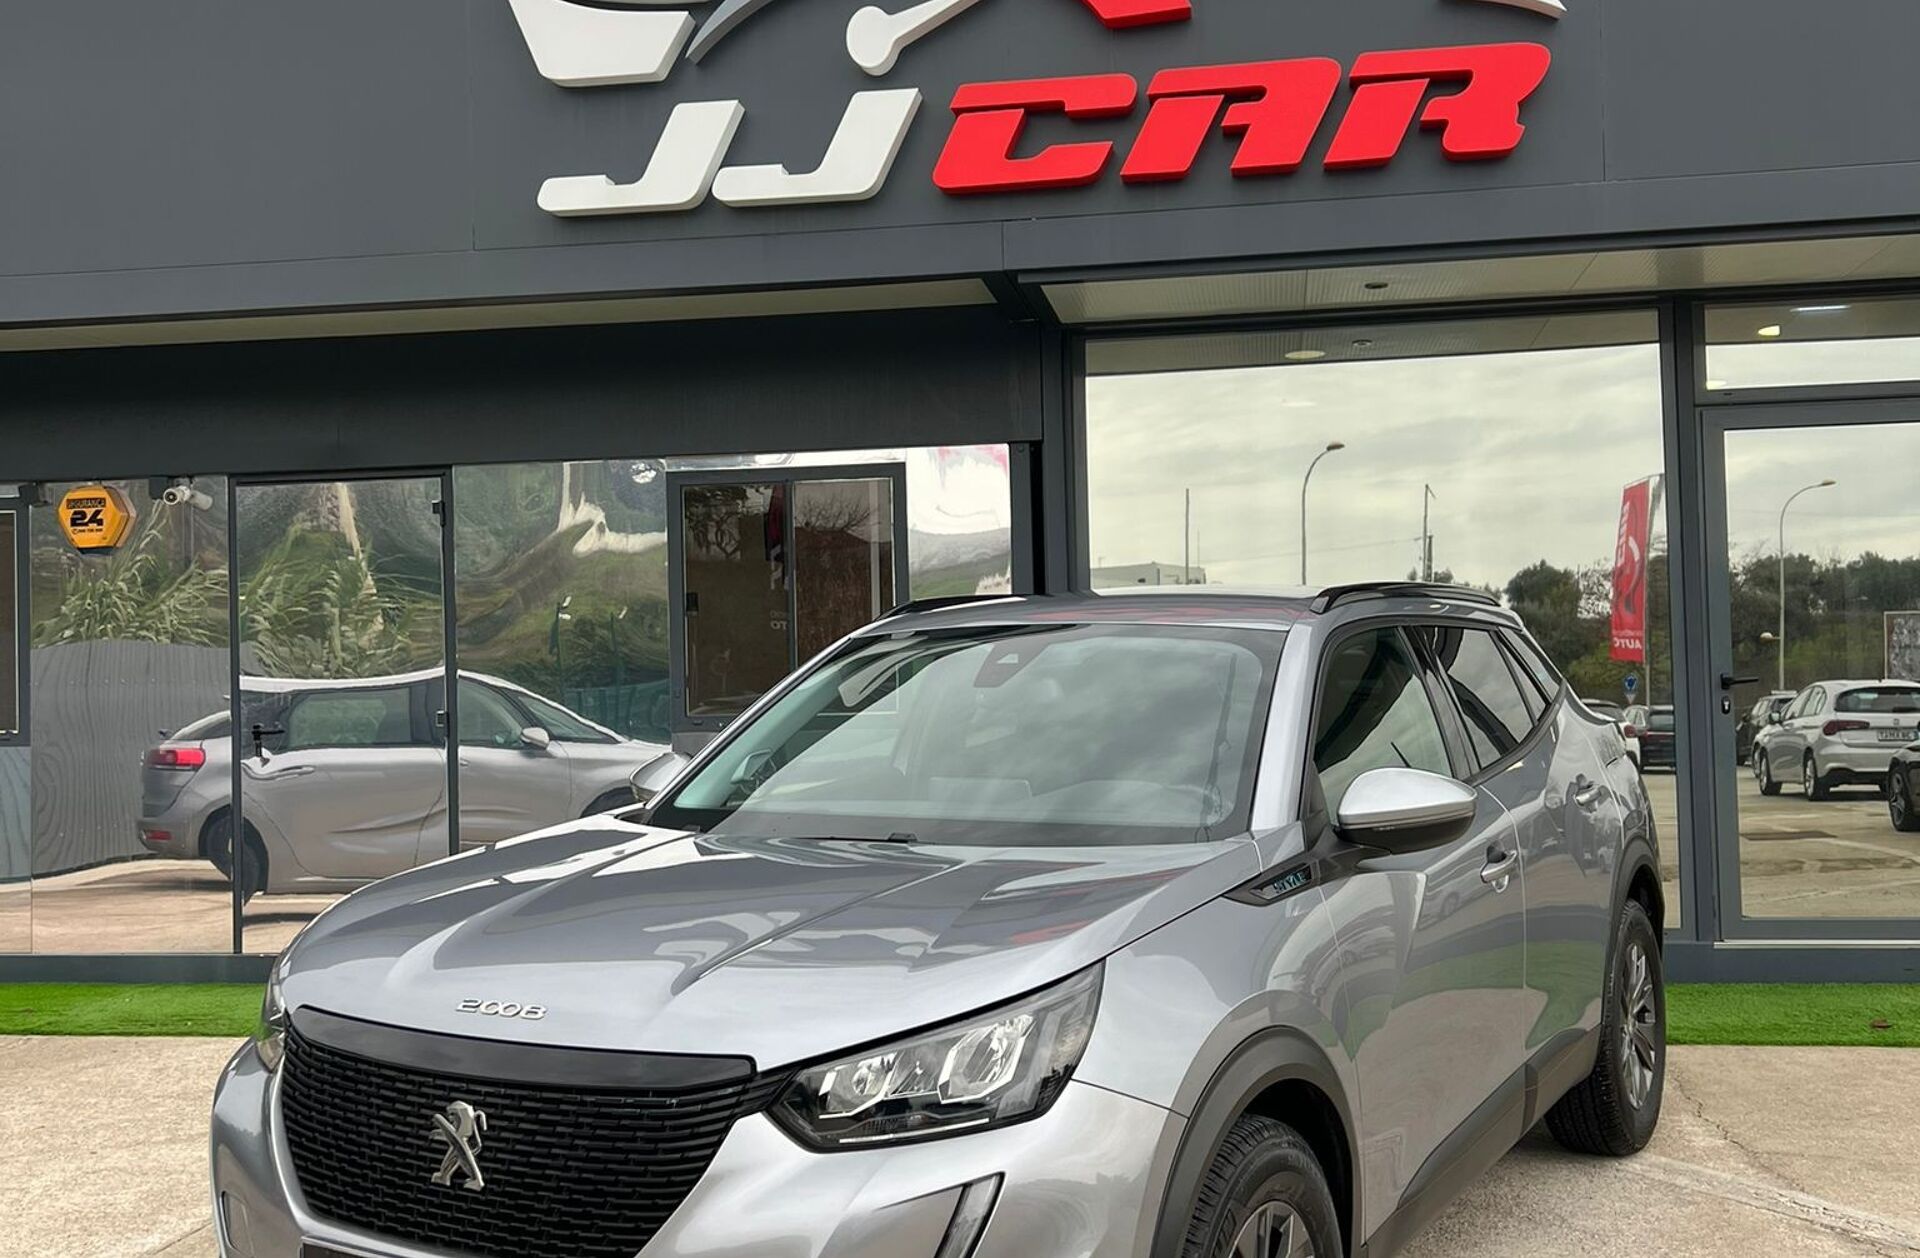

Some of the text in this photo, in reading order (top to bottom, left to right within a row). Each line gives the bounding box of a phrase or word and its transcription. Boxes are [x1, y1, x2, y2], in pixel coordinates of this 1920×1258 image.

[537, 42, 1551, 217] JJ CAR
[70, 509, 104, 527] 24
[456, 998, 546, 1020] 2008
